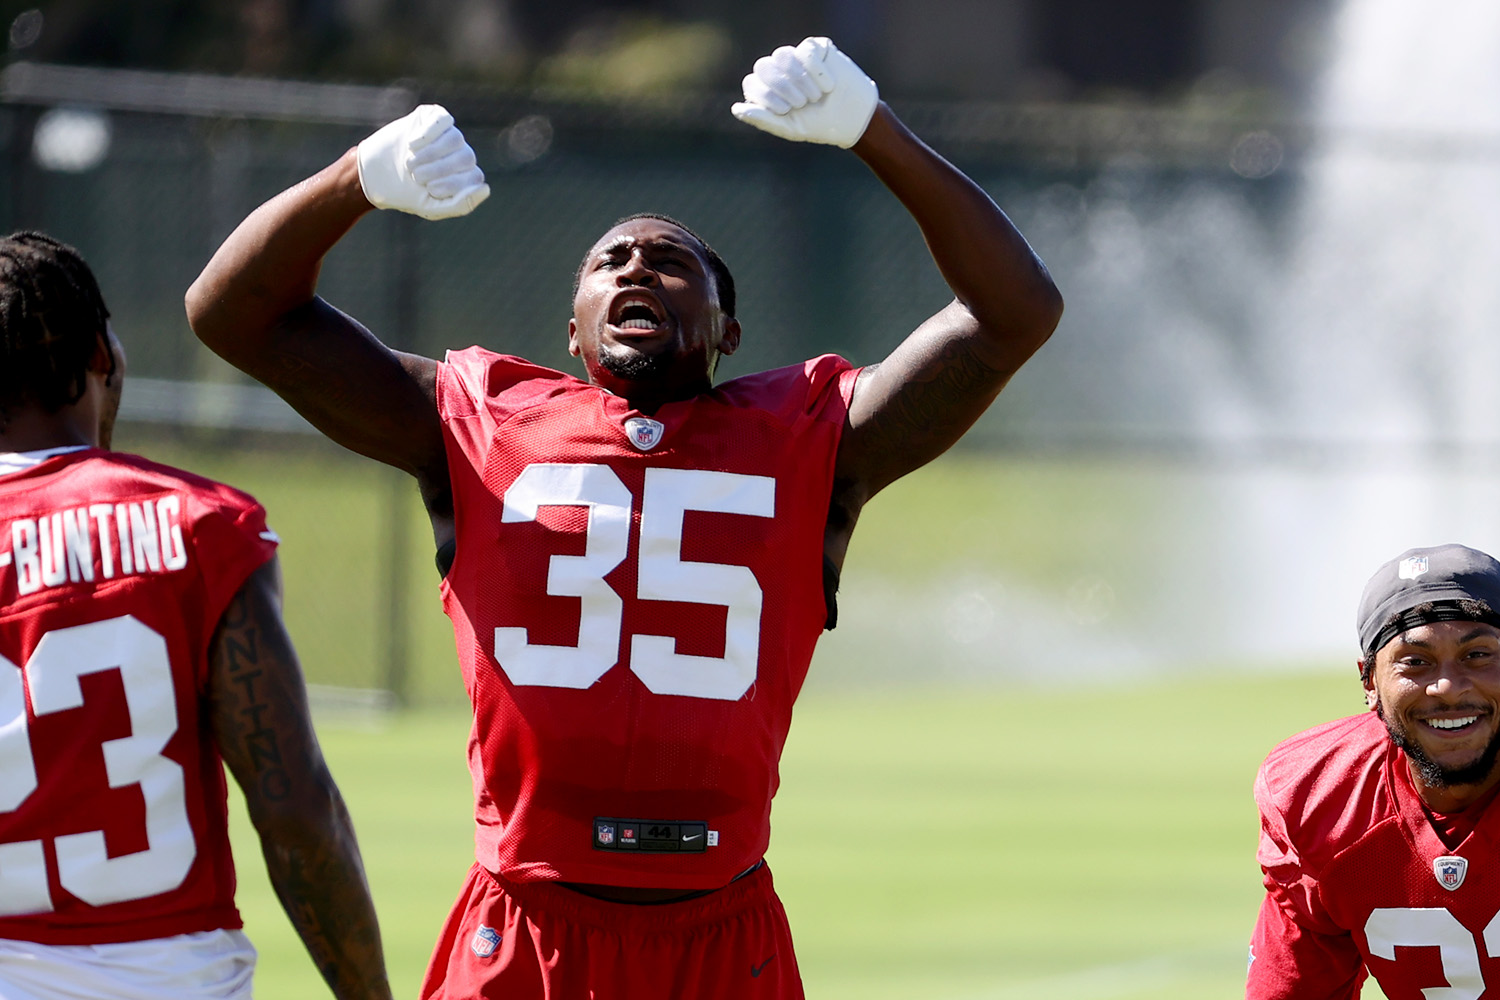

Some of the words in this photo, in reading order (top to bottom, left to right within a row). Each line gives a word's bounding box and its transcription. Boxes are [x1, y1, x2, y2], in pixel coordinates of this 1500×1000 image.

[494, 463, 776, 702] 35
[648, 826, 672, 839] 44
[1444, 874, 1458, 883] NFL
